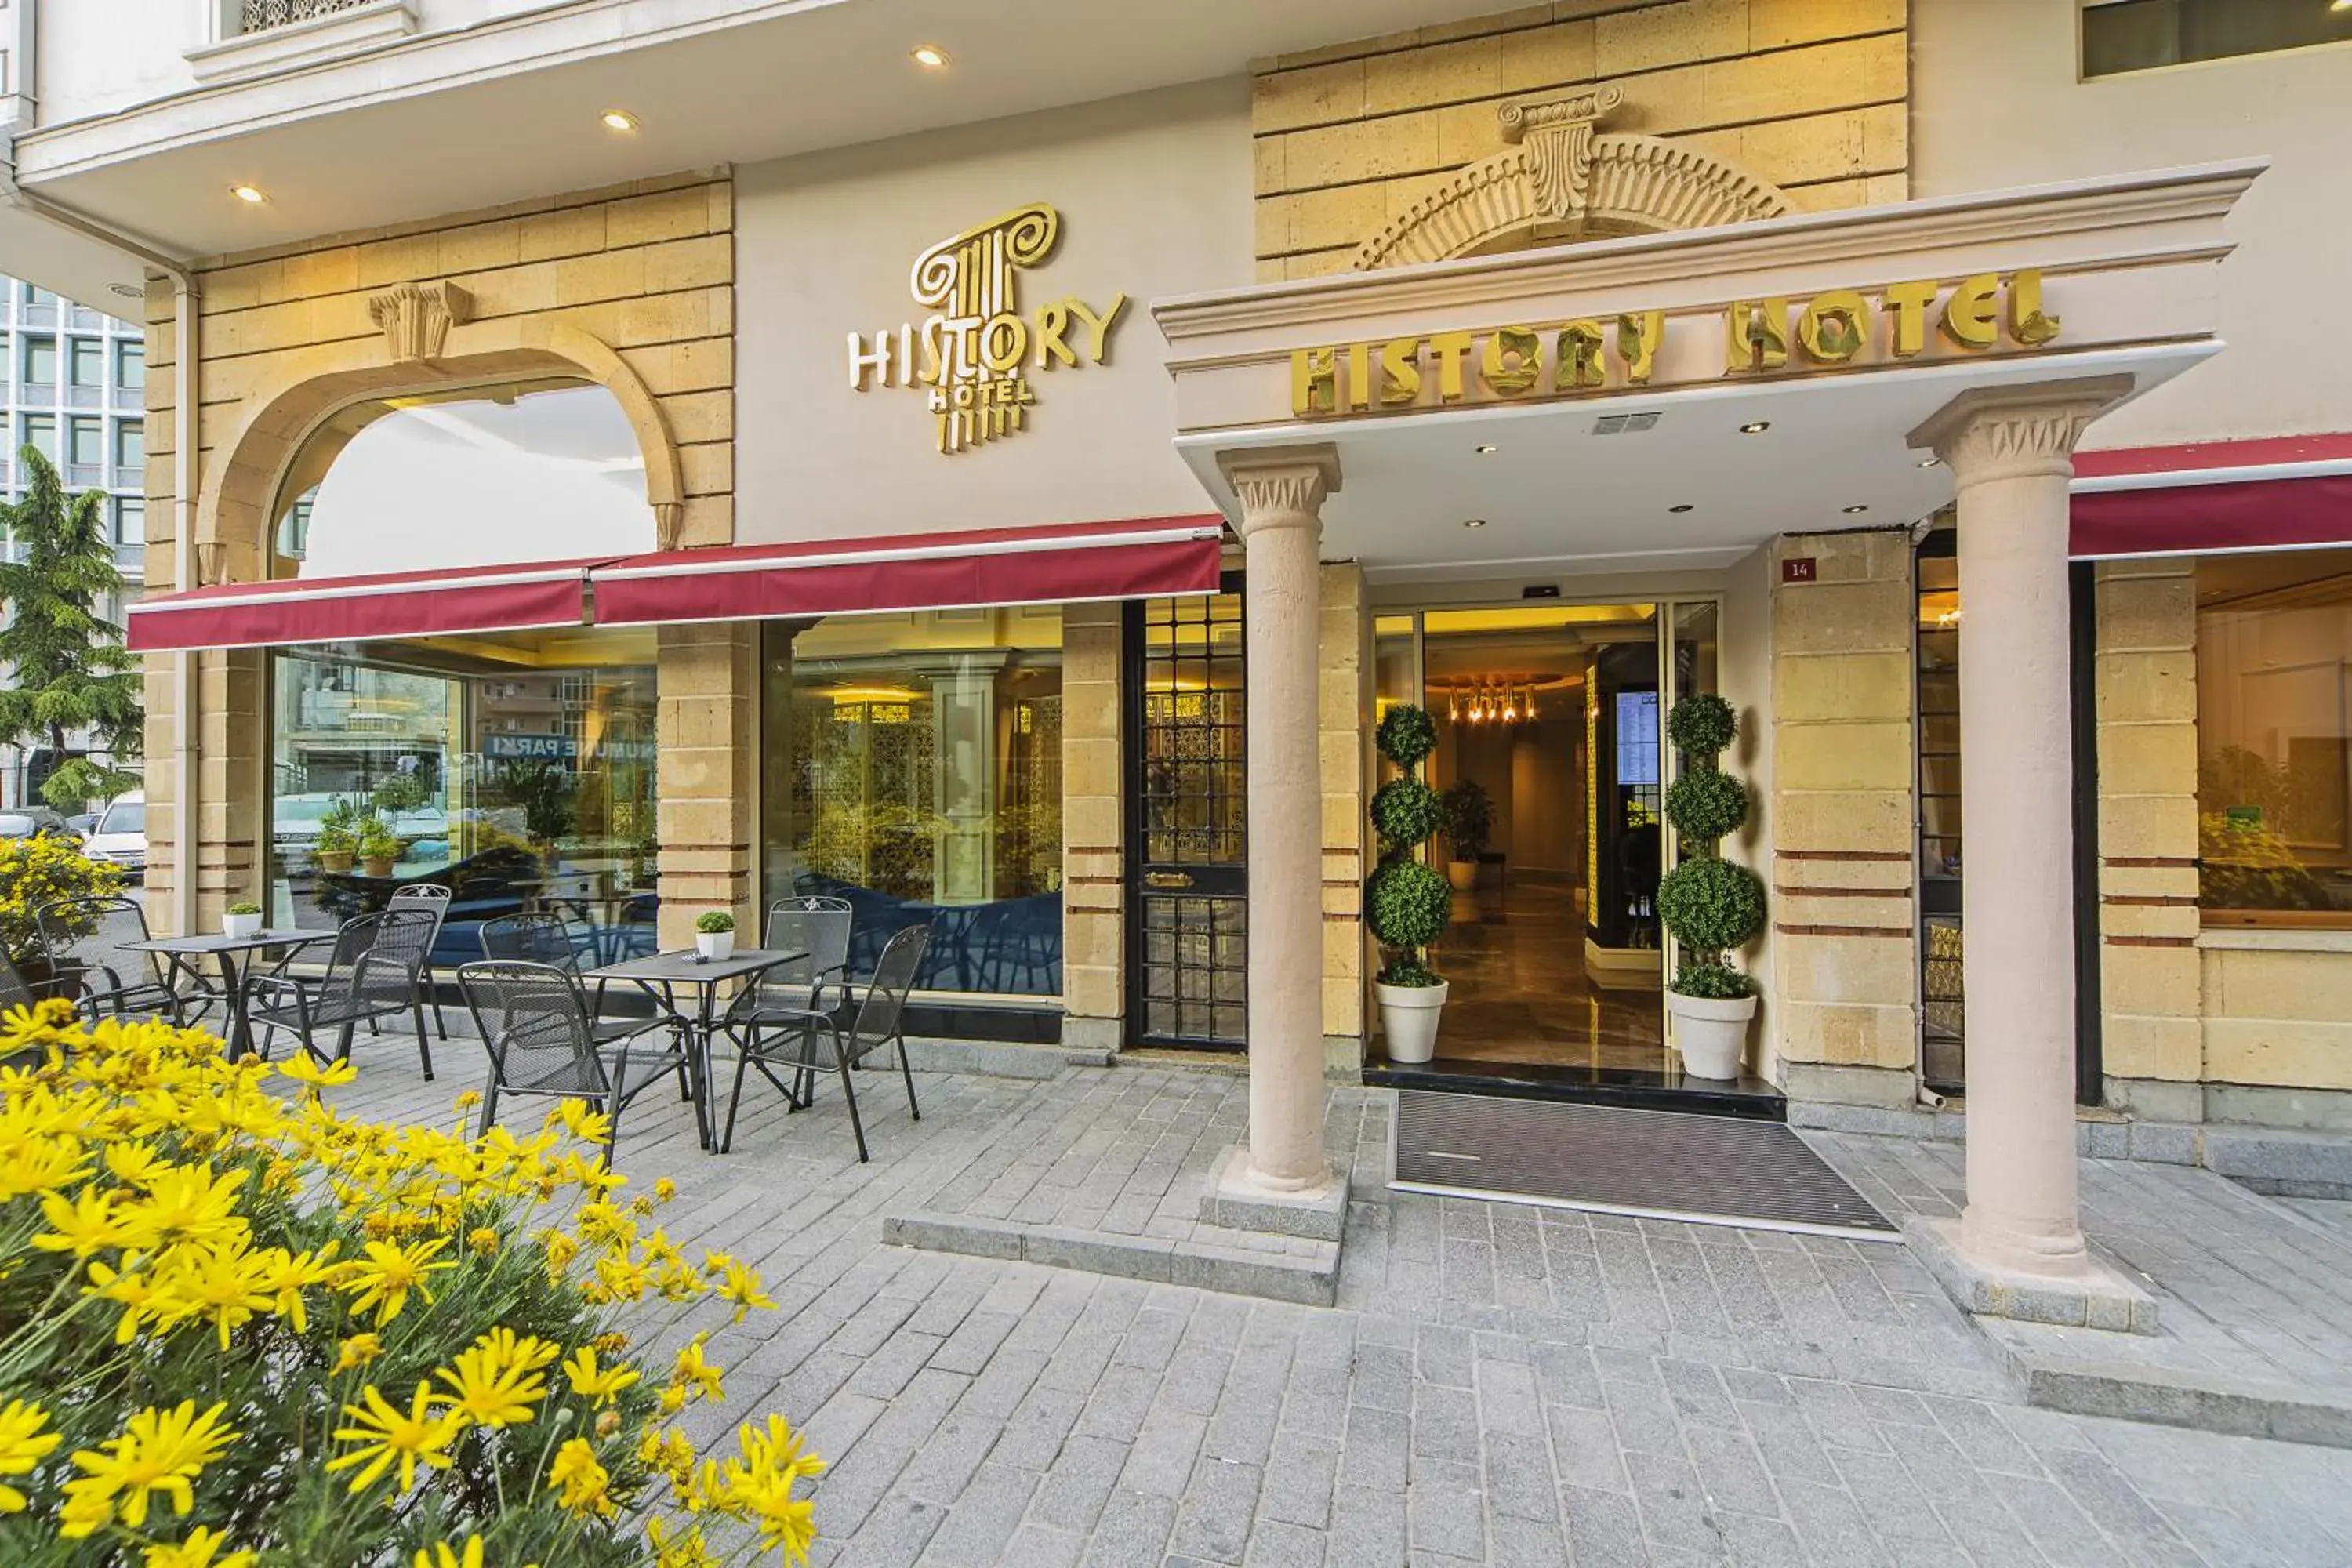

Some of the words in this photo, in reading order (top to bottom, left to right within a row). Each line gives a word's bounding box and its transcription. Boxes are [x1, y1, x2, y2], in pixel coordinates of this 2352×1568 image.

[847, 292, 1127, 388] HISTORY
[1294, 311, 1665, 416] HISTORY
[1723, 270, 2060, 375] HOTEL
[930, 379, 1034, 413] HOTEL
[1793, 564, 1807, 576] 14
